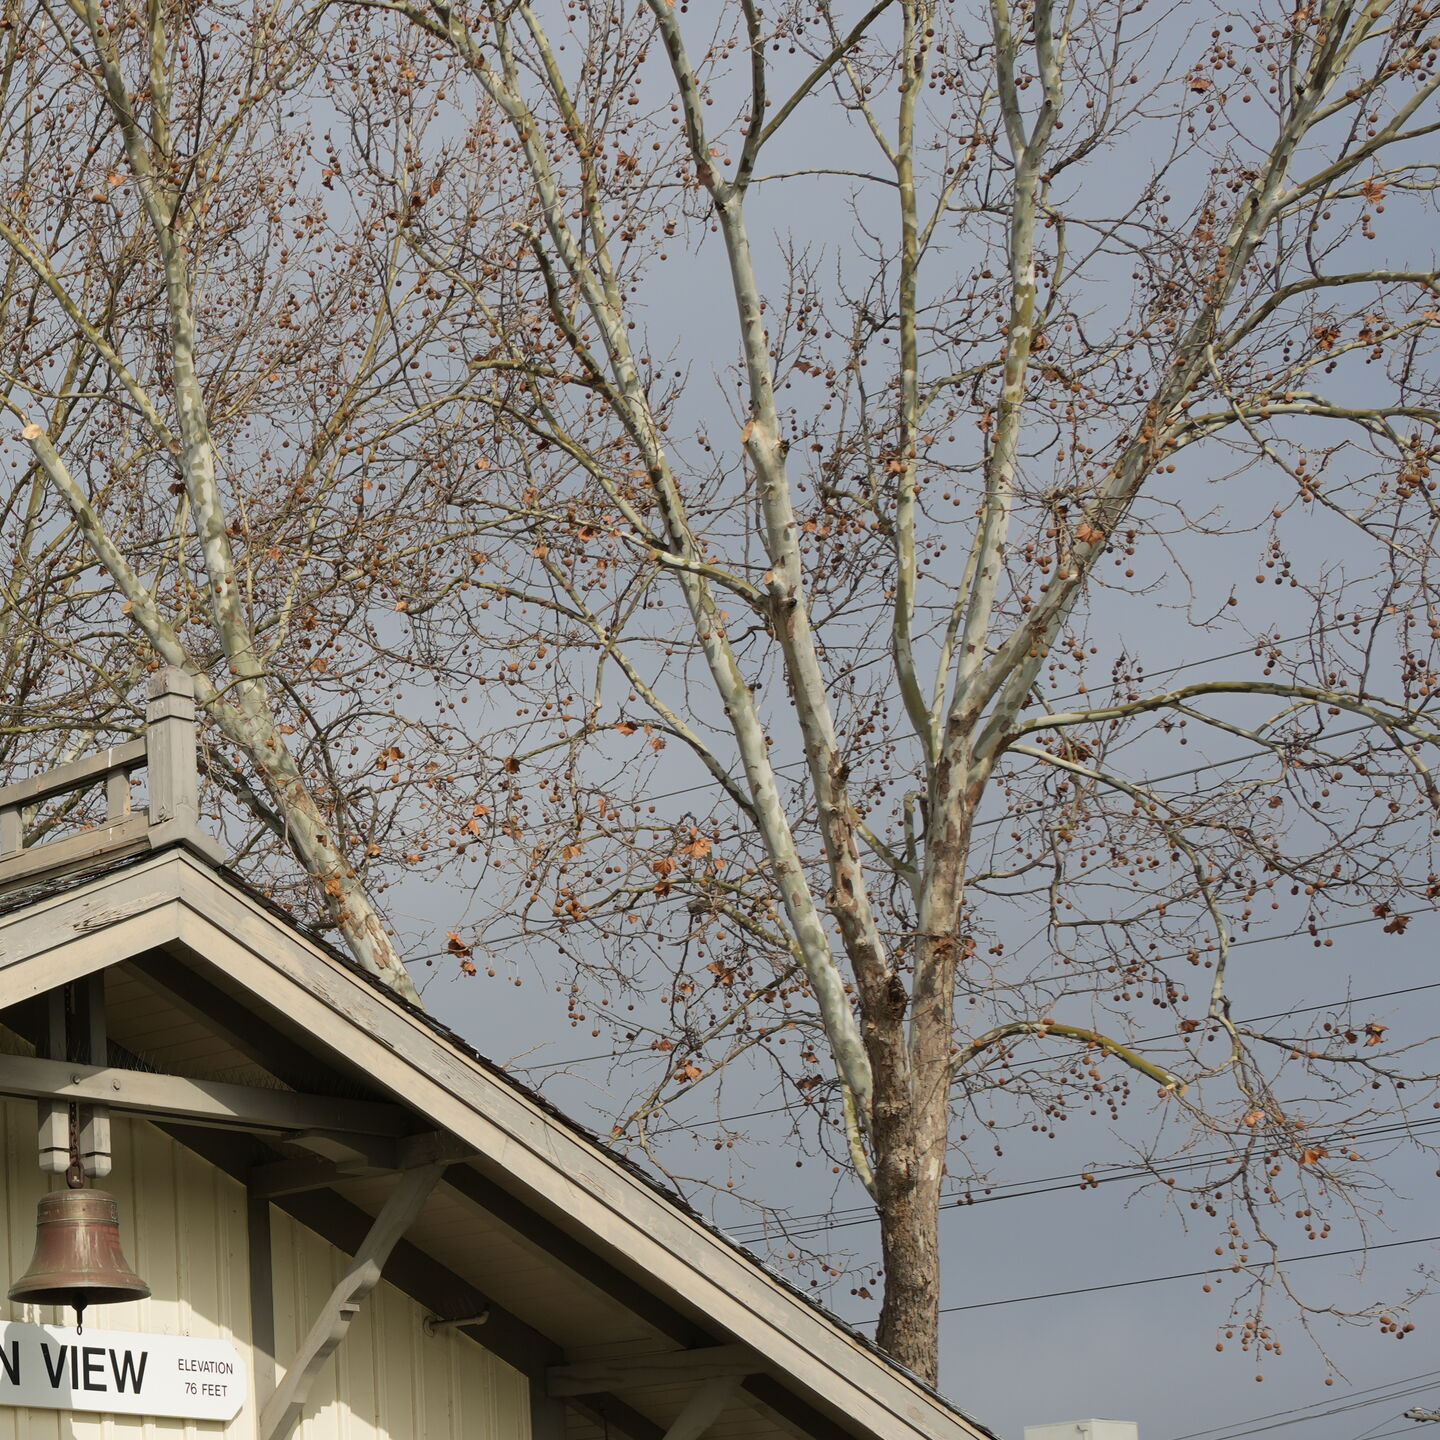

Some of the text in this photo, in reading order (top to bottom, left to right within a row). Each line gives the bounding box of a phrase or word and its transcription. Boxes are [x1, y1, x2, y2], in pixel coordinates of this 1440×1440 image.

[40, 1342, 148, 1395] VIEW
[178, 1358, 233, 1375] ELEVATION
[185, 1382, 228, 1397] 76 FEET
